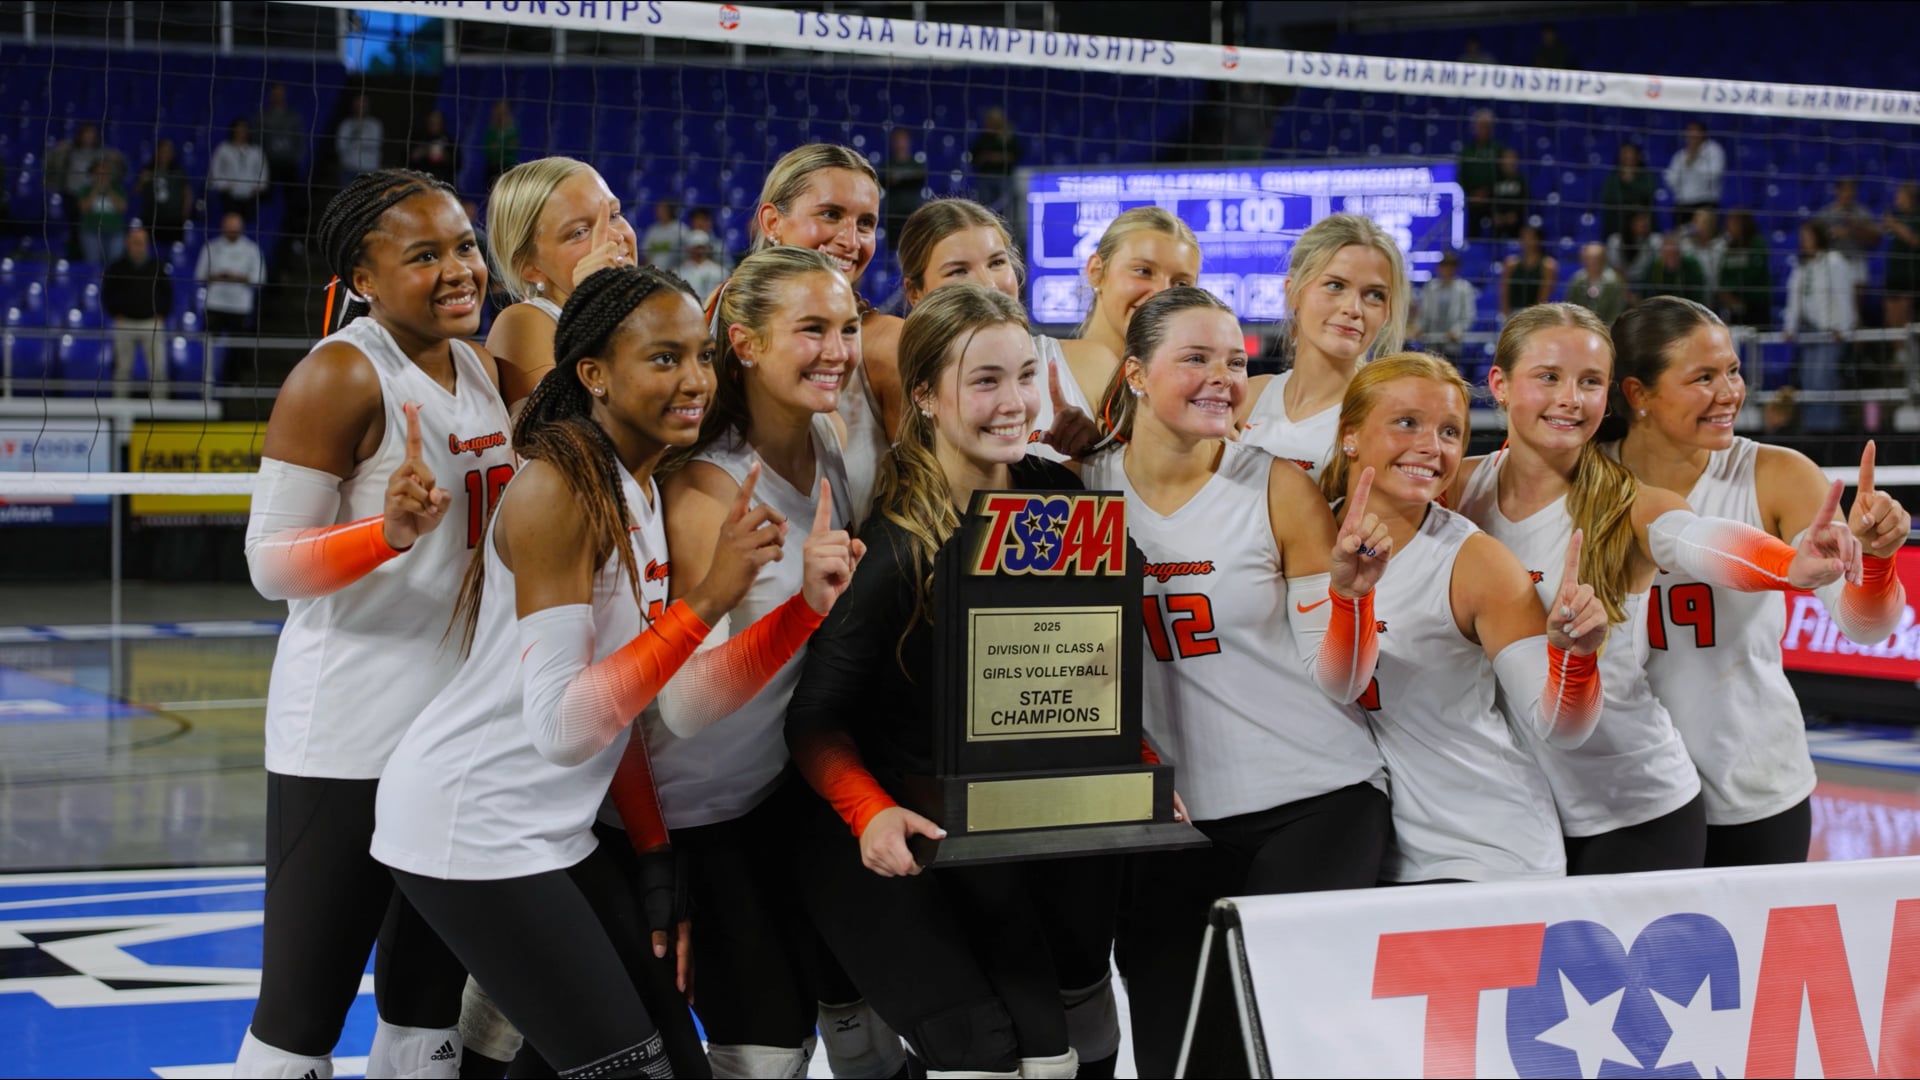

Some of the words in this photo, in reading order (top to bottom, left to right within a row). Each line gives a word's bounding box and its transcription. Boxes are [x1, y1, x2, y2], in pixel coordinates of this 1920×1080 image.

[794, 10, 894, 43] TSSAA
[914, 21, 1176, 66] CHAMPIONSHIPS
[1285, 52, 1369, 80] TSSAA
[1384, 61, 1607, 95] CHAMPIONSHIPS
[1701, 82, 1774, 105] TSSAA
[1205, 198, 1285, 232] 1:00
[448, 430, 507, 457] Cougars
[972, 495, 1127, 575] TSSAA
[1143, 556, 1216, 583] ougars
[1033, 622, 1061, 632] 2025
[1142, 592, 1221, 662] 12
[1647, 582, 1726, 650] 19
[987, 644, 1040, 656] DIVISION
[1043, 643, 1051, 654] II
[1055, 643, 1095, 654] CLASS
[1096, 642, 1105, 653] A
[982, 667, 1023, 680] GIRLS
[1025, 664, 1109, 679] VOLLEYBALL
[1019, 689, 1073, 706] STATE
[990, 707, 1101, 726] CHAMPIONS
[1371, 898, 1920, 1079] TSSA
